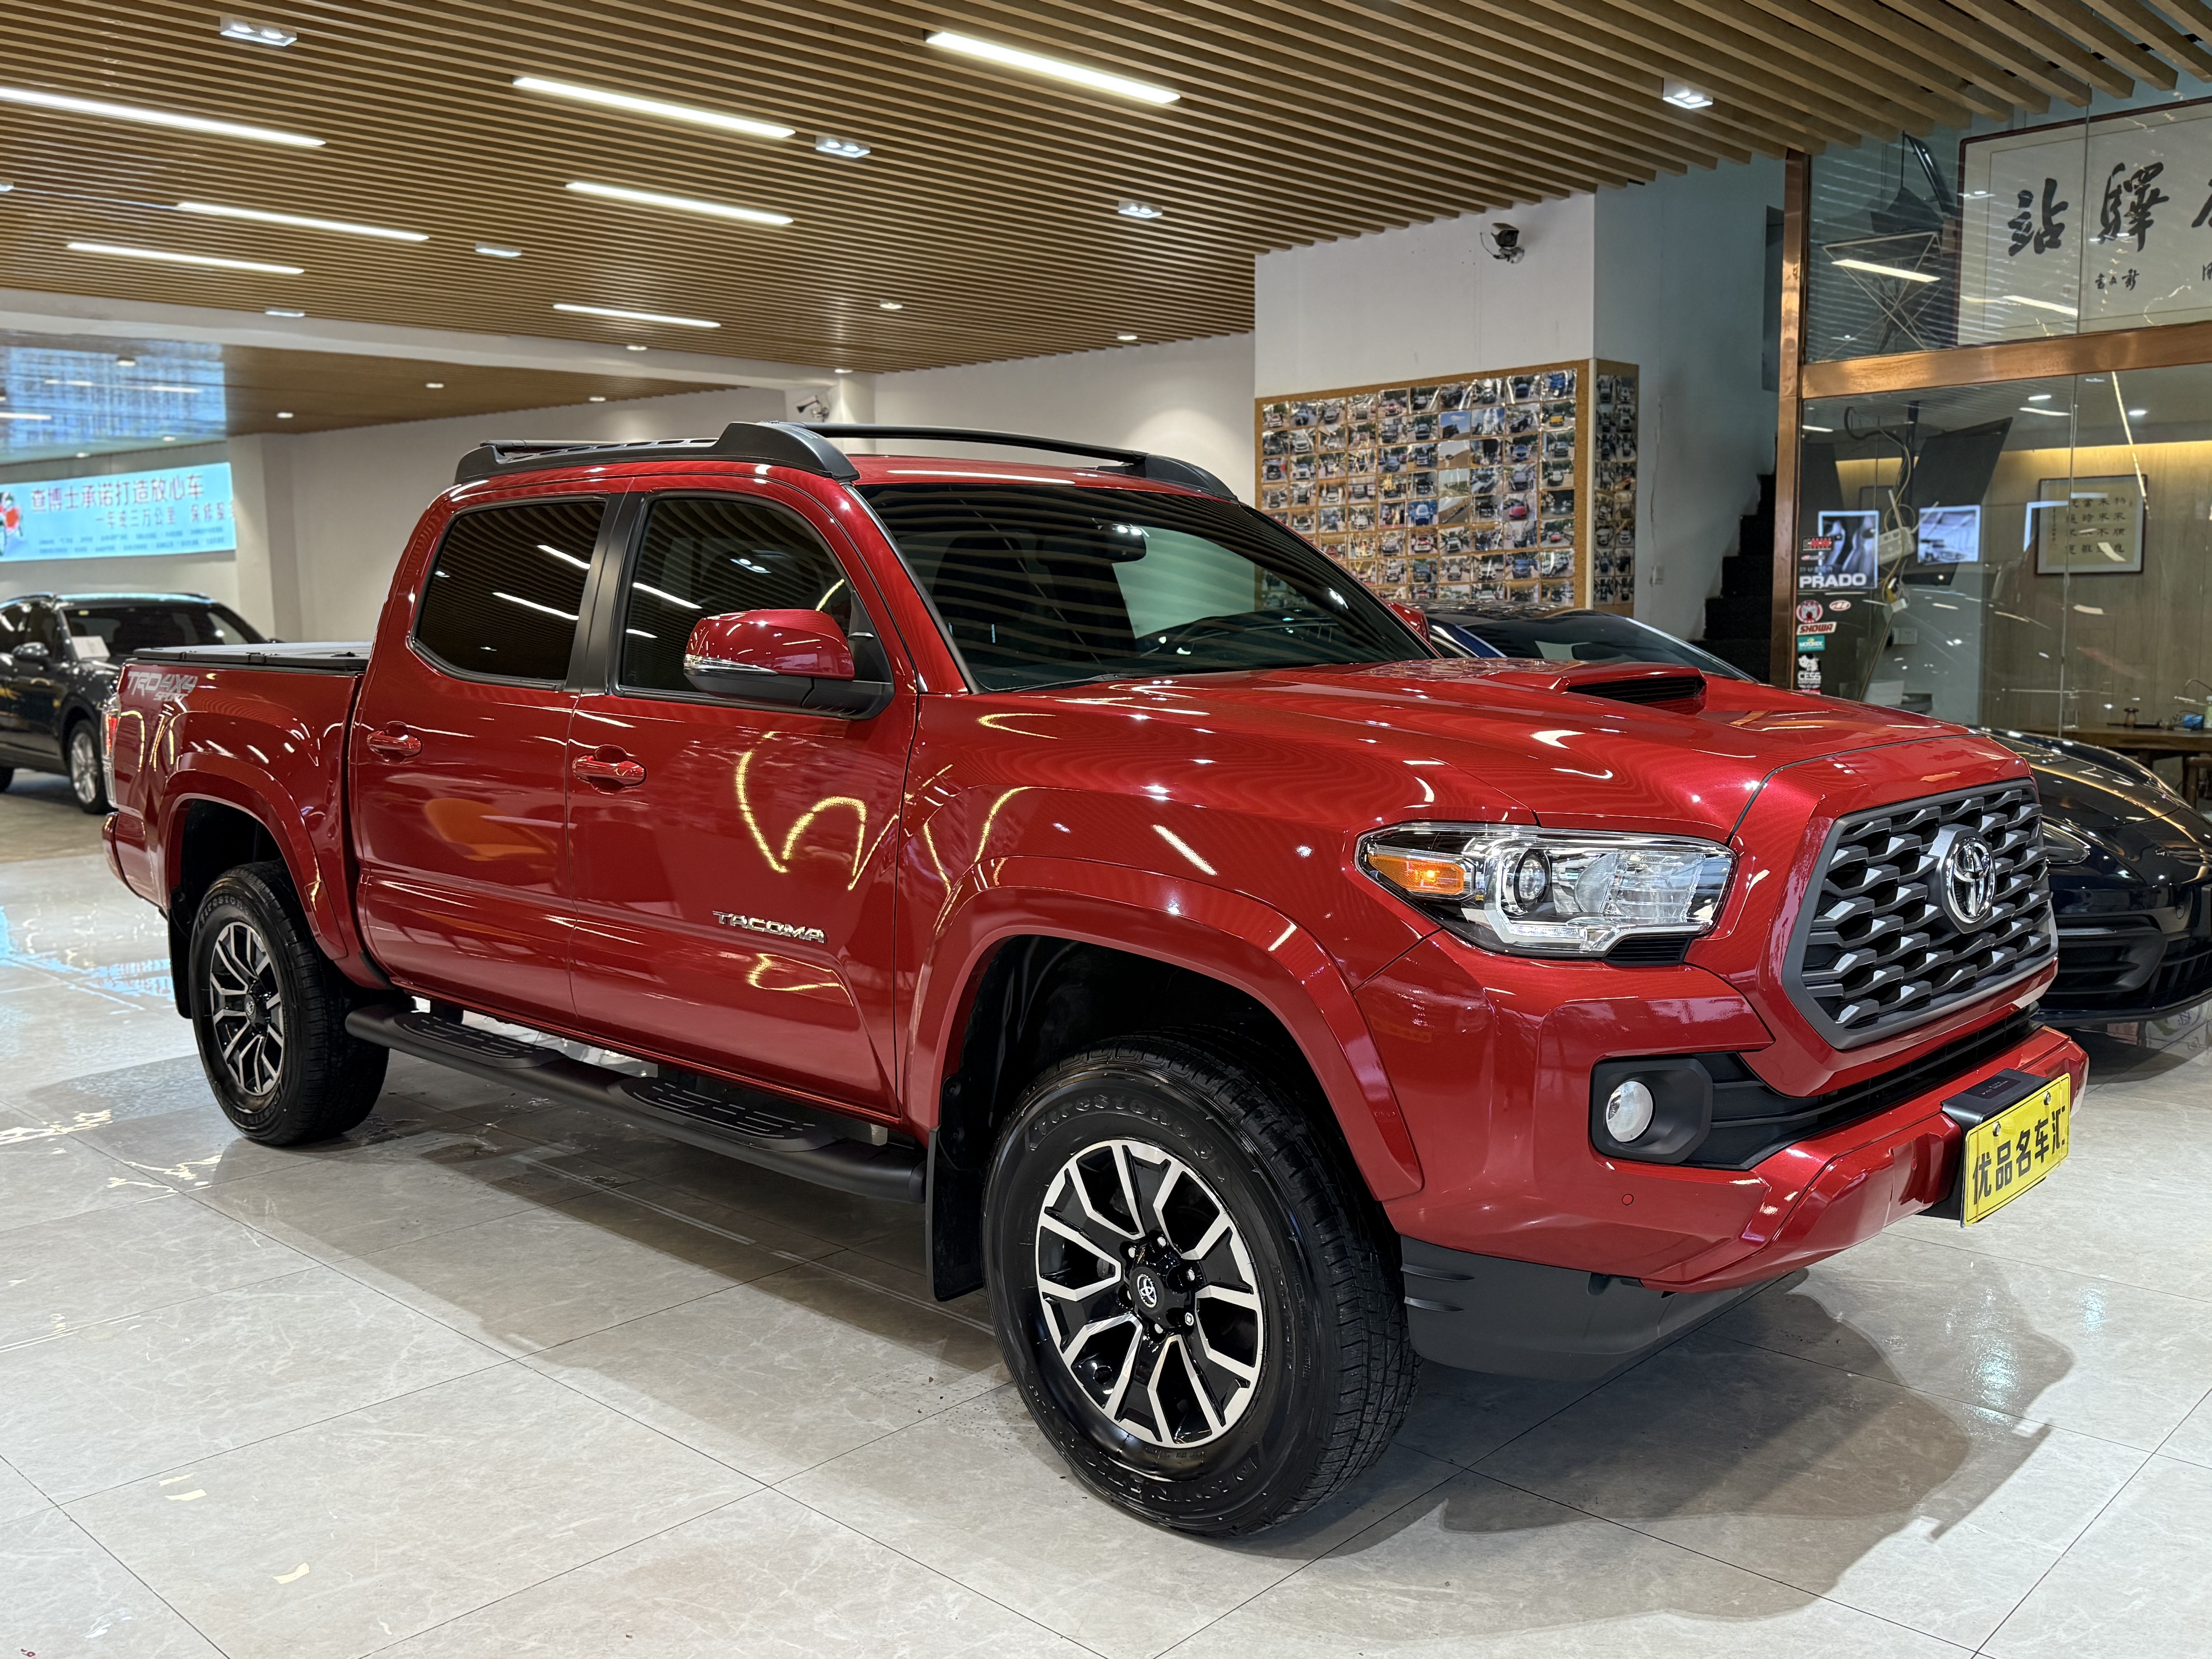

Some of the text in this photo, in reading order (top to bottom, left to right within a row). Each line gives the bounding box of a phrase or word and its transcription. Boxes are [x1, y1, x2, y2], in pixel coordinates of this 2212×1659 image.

[1800, 573, 1867, 588] PRADO
[1800, 623, 1834, 633] SHOWA
[128, 671, 162, 696] TRD
[153, 692, 189, 701] SPORT
[713, 910, 828, 944] TACOMA
[1972, 1105, 2066, 1205] 优品名车汇
